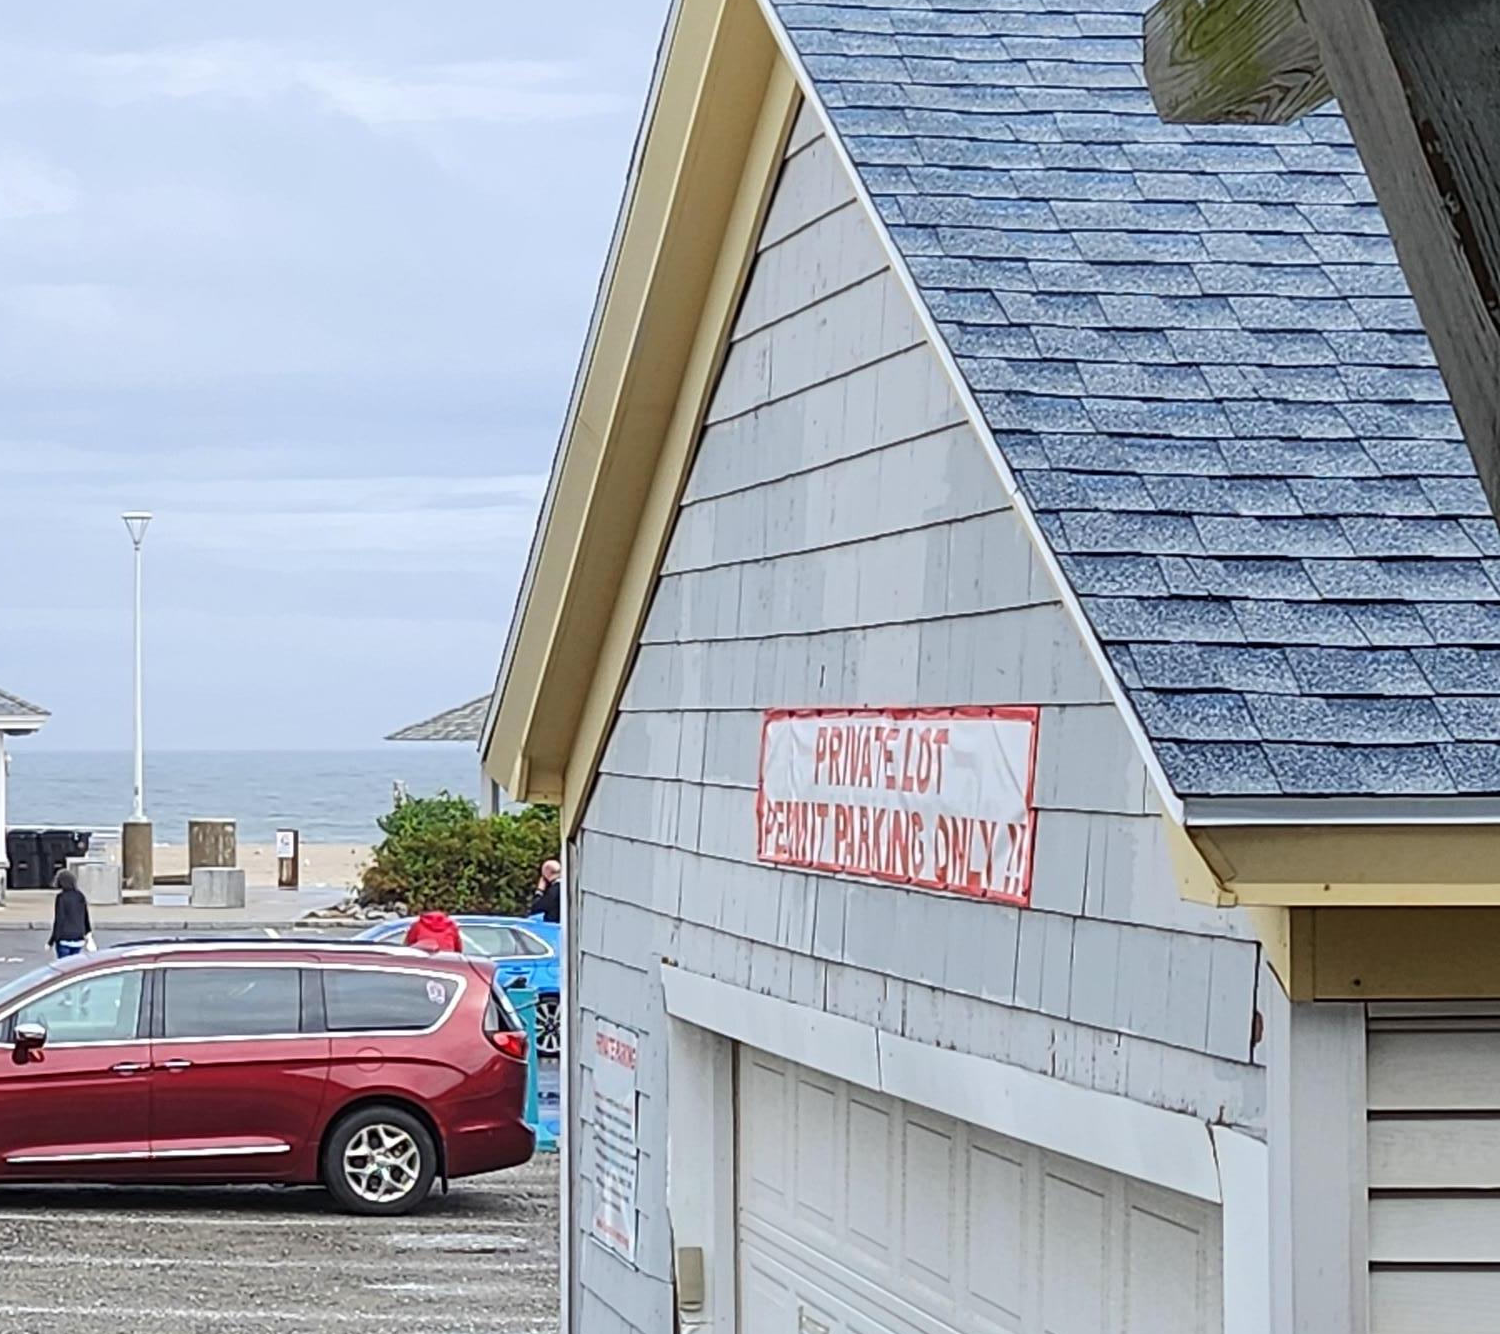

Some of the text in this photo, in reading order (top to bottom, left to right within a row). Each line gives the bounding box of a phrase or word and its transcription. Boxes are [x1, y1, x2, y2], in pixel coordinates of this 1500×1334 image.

[814, 725, 949, 796] PRIVATE LOT
[764, 799, 829, 860] PERMIT
[834, 802, 925, 878] PARKING
[934, 813, 997, 889] ONLY
